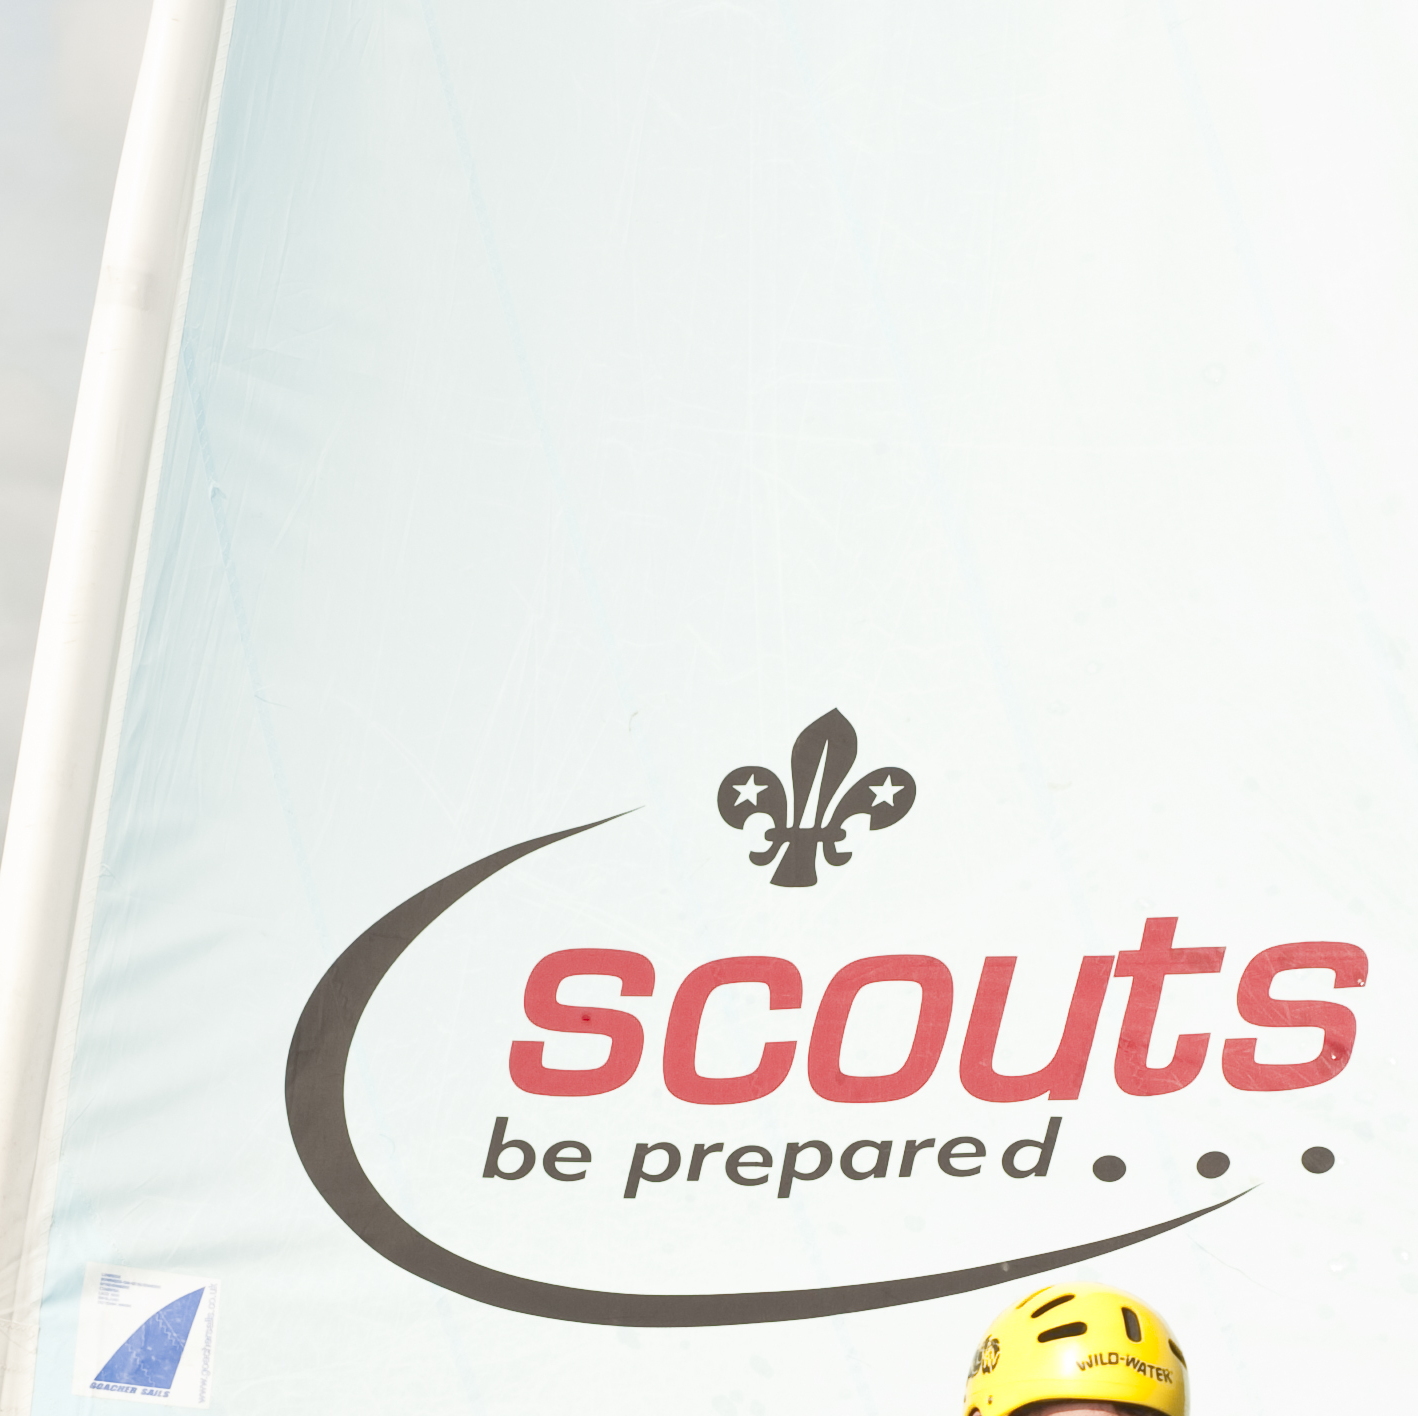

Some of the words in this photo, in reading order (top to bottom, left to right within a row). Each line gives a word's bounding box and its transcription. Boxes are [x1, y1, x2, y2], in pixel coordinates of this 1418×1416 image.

[509, 917, 1369, 1105] scouts
[482, 1116, 593, 1182] be
[89, 1382, 138, 1395] GOACHER
[141, 1388, 171, 1399] SAILS
